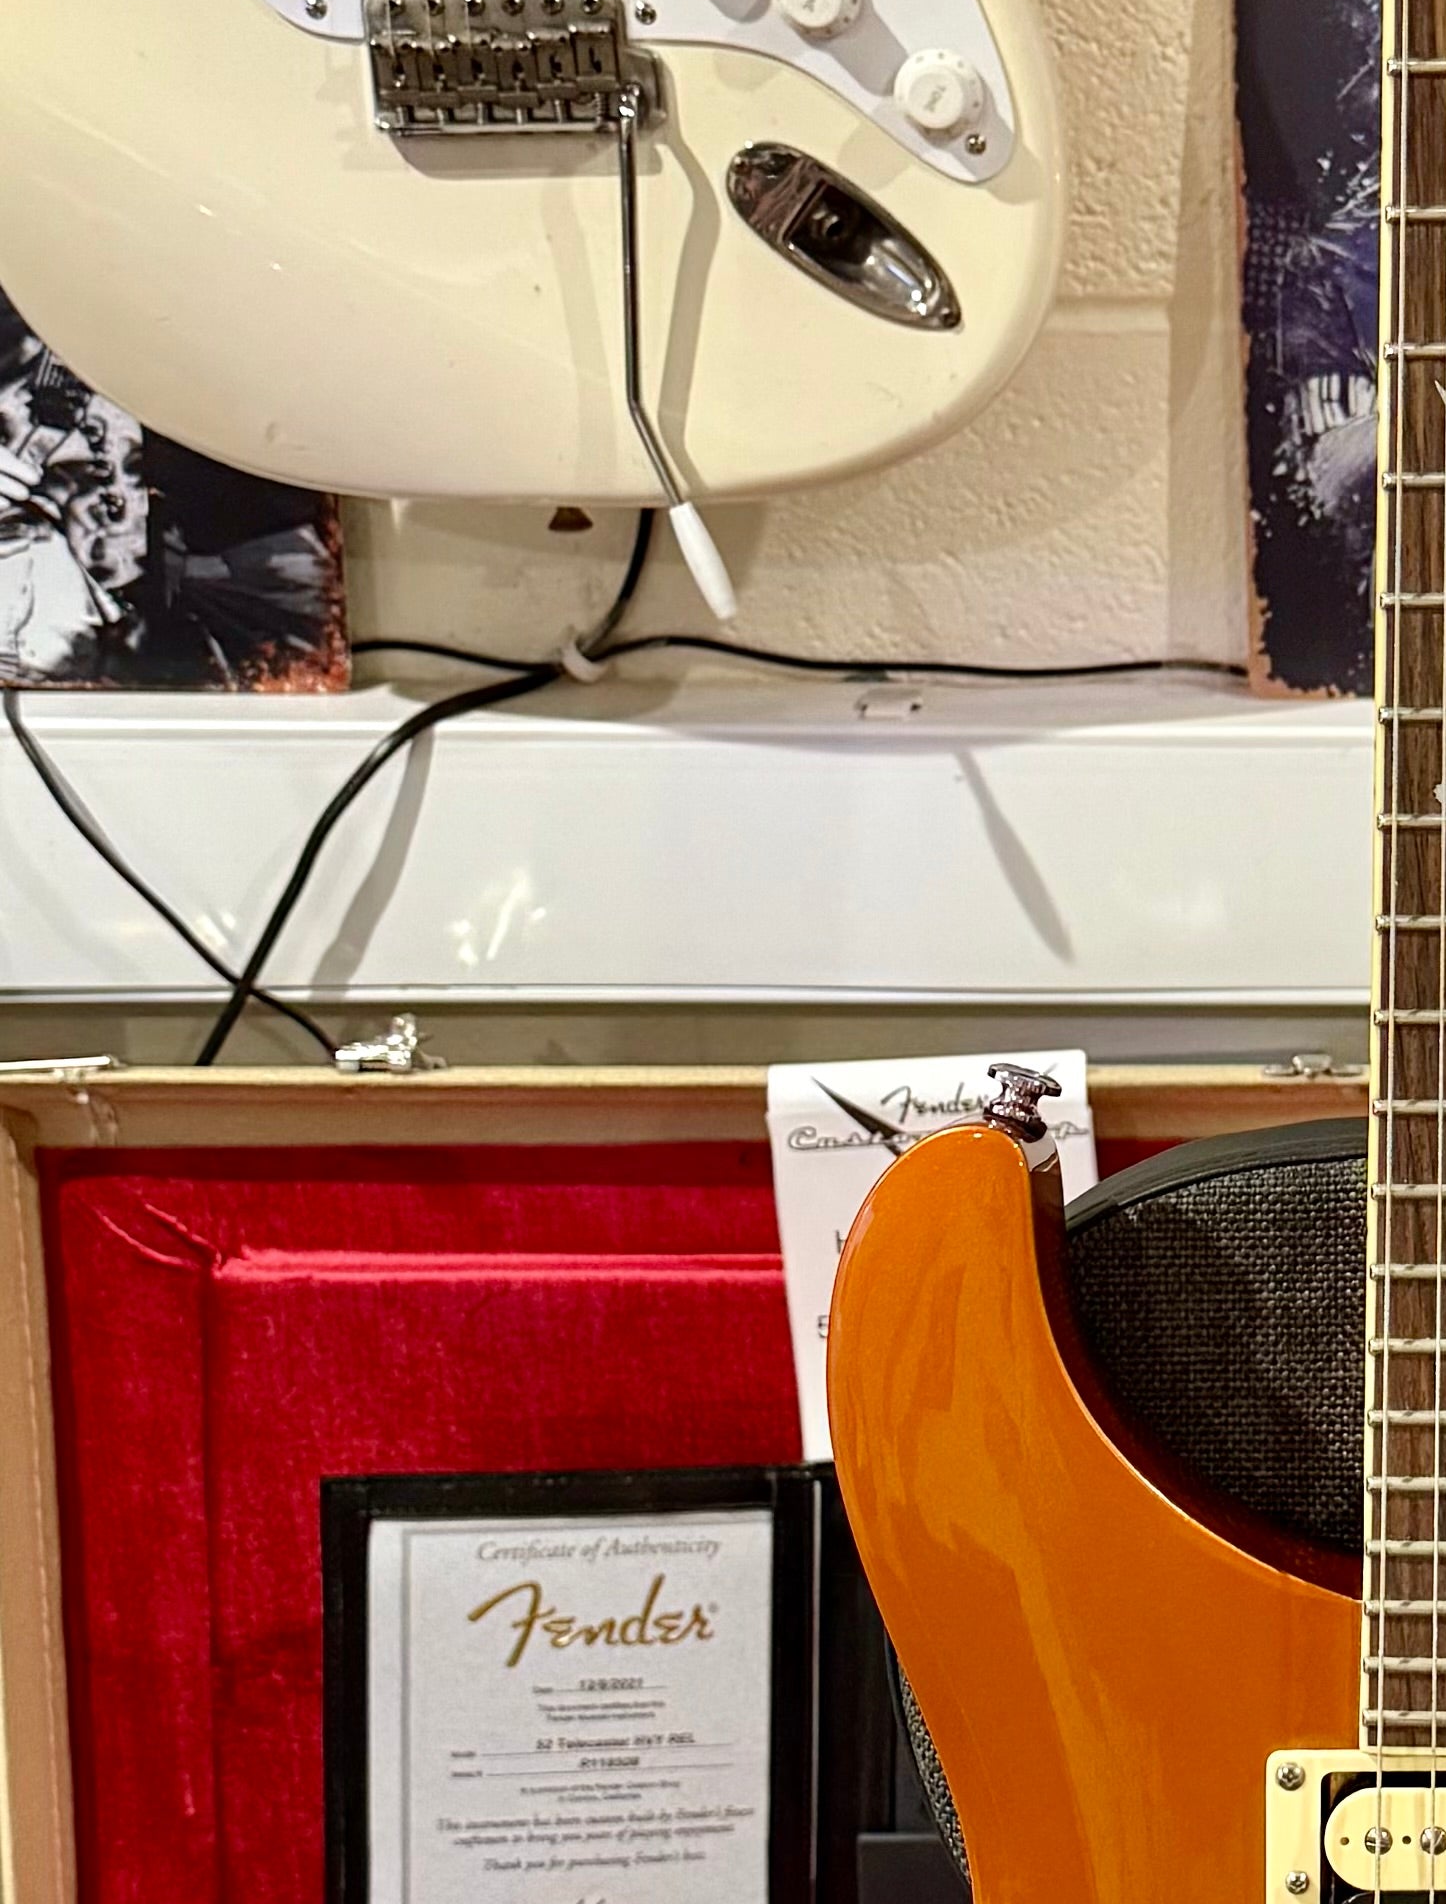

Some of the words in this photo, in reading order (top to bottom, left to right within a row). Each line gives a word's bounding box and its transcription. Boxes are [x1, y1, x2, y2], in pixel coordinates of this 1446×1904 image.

[476, 1539, 574, 1566] Certificate
[579, 1536, 602, 1566] of
[602, 1534, 722, 1561] Authenticity
[467, 1572, 714, 1668] Fender
